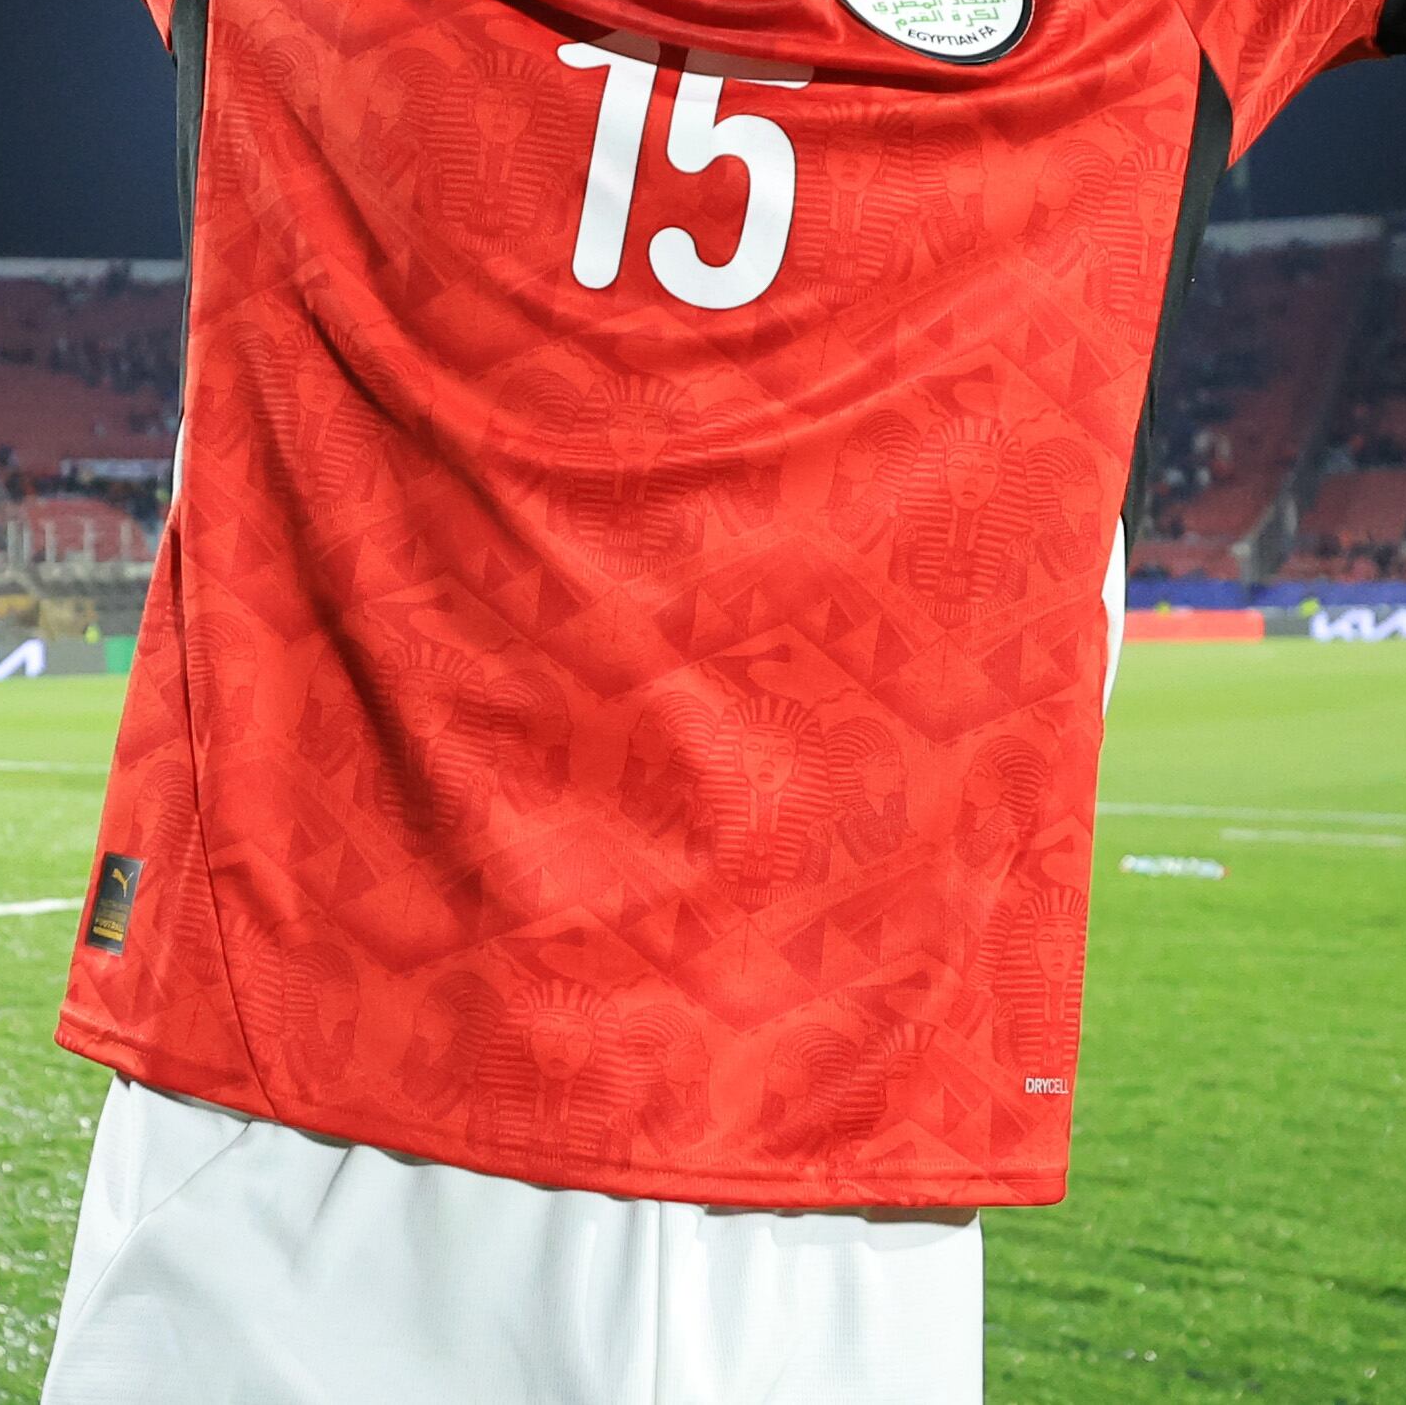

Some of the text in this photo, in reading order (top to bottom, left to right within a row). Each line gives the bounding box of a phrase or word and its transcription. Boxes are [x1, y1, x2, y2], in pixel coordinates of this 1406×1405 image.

[907, 25, 998, 46] EGYPTIAN FA
[556, 28, 815, 310] 15
[1024, 1077, 1070, 1095] DRYCELL
